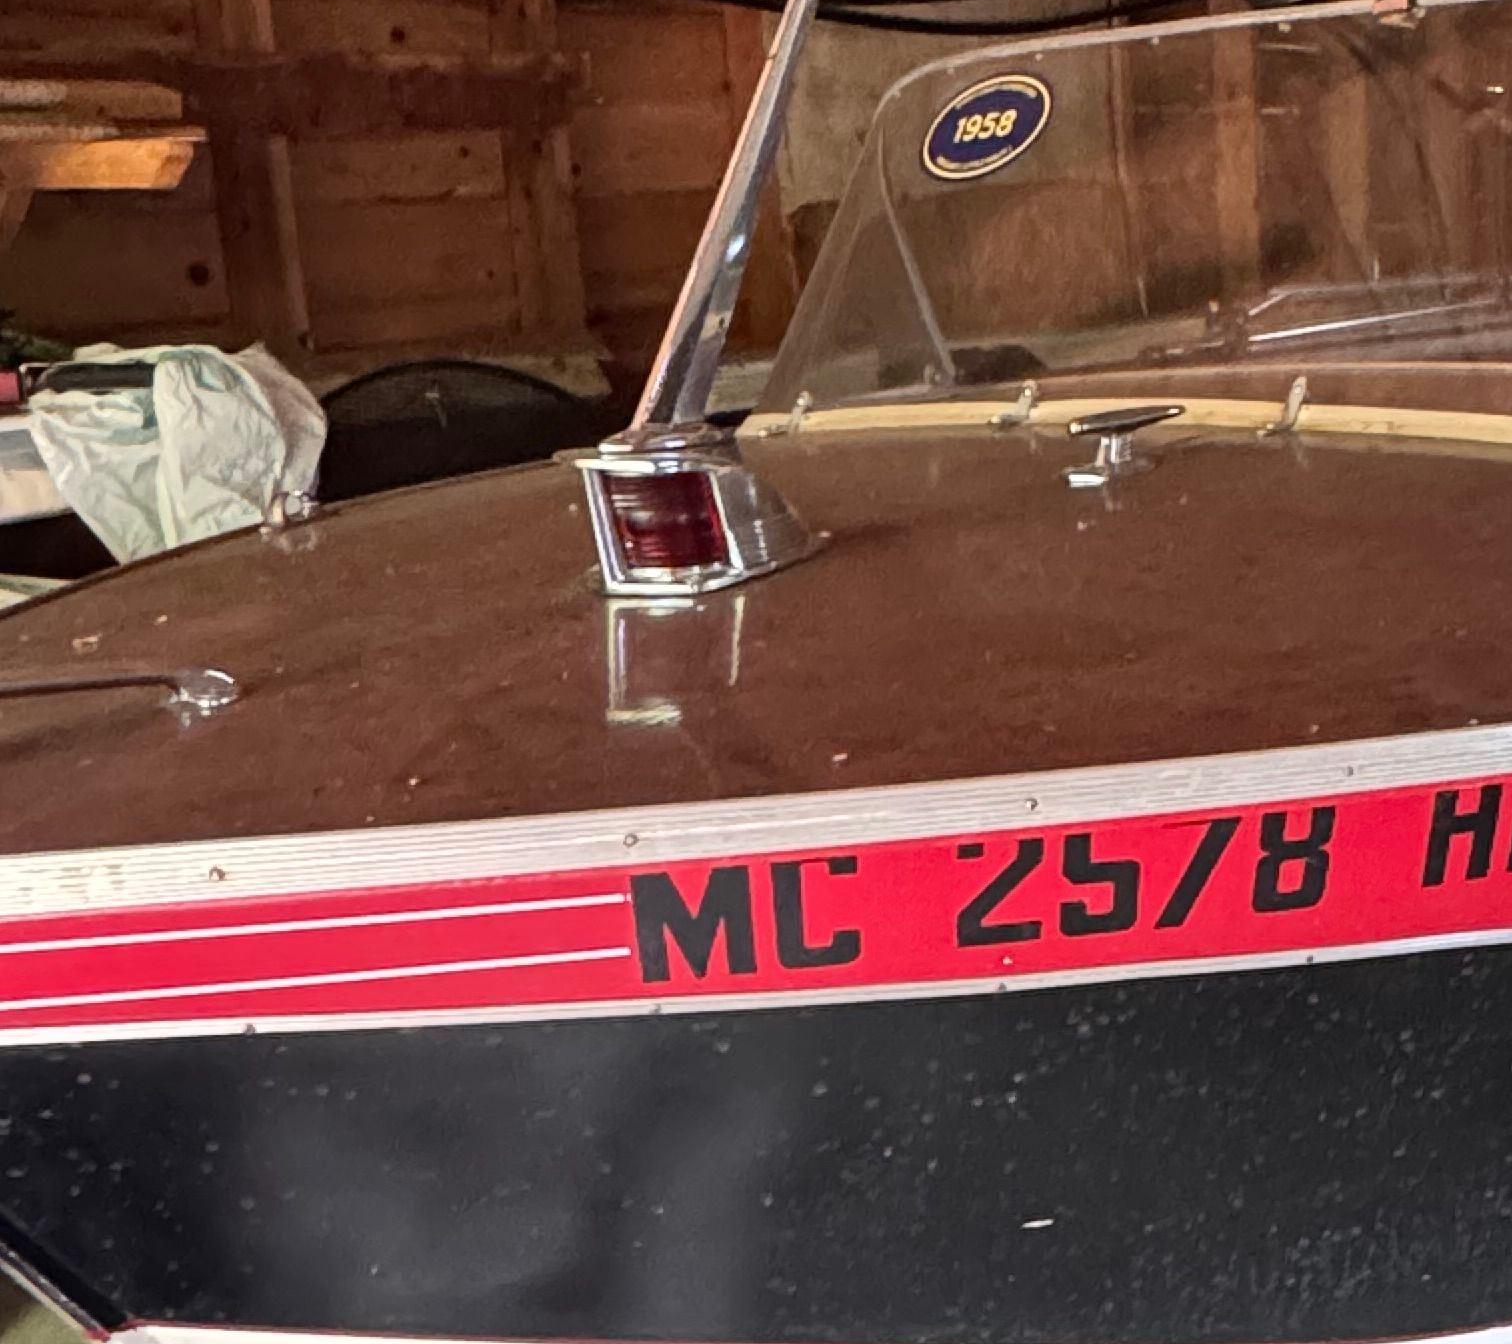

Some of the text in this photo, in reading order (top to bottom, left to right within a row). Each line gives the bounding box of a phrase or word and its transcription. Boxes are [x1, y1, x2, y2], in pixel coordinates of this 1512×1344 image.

[952, 109, 1018, 144] 1958
[630, 855, 861, 984] MC
[956, 805, 1337, 948] 2578
